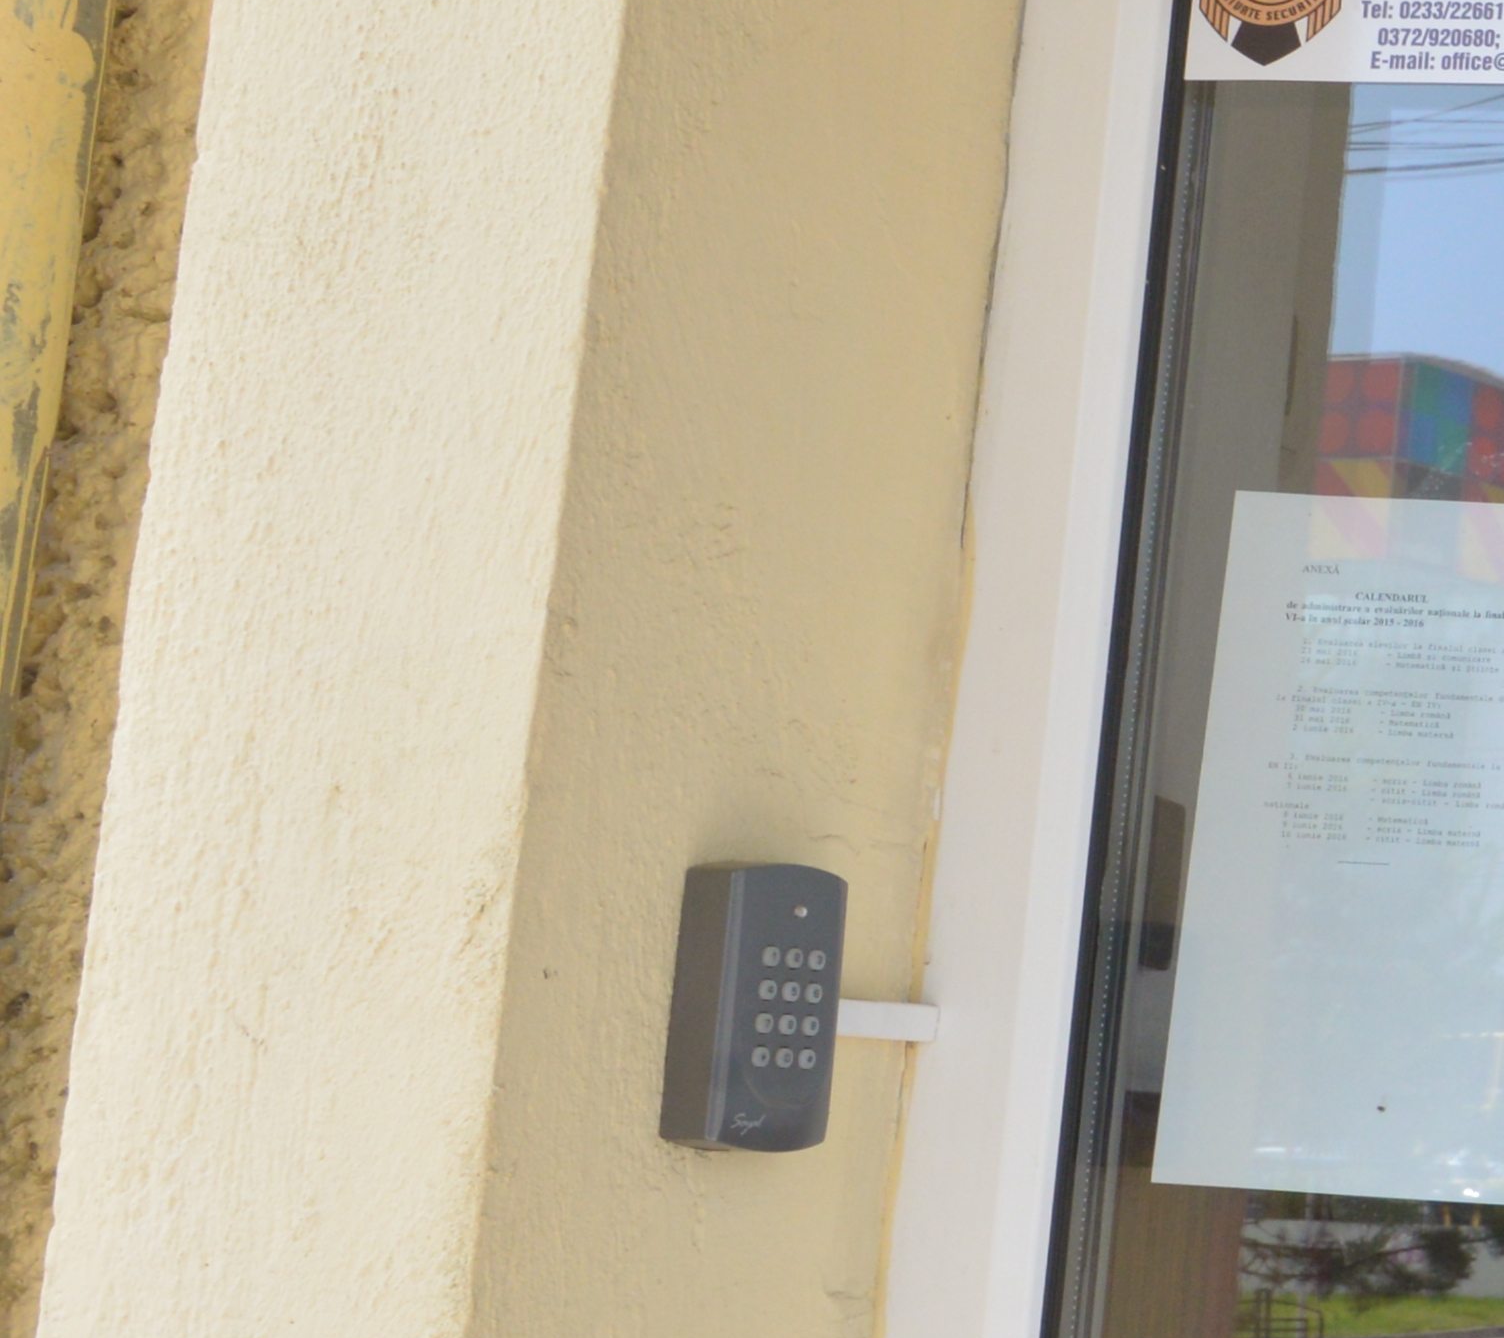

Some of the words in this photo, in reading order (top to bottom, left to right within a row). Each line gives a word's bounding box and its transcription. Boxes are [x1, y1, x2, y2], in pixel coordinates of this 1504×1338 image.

[1361, 0, 1394, 19] Tel:
[1377, 27, 1501, 50] 0372/920680;
[1369, 50, 1436, 70] E-mail:
[1355, 591, 1429, 604] CALENDARUL
[1286, 601, 1298, 610] de
[1301, 602, 1361, 613] administrare
[1473, 610, 1482, 618] la
[1321, 615, 1341, 624] anul
[1403, 618, 1425, 628] 2016
